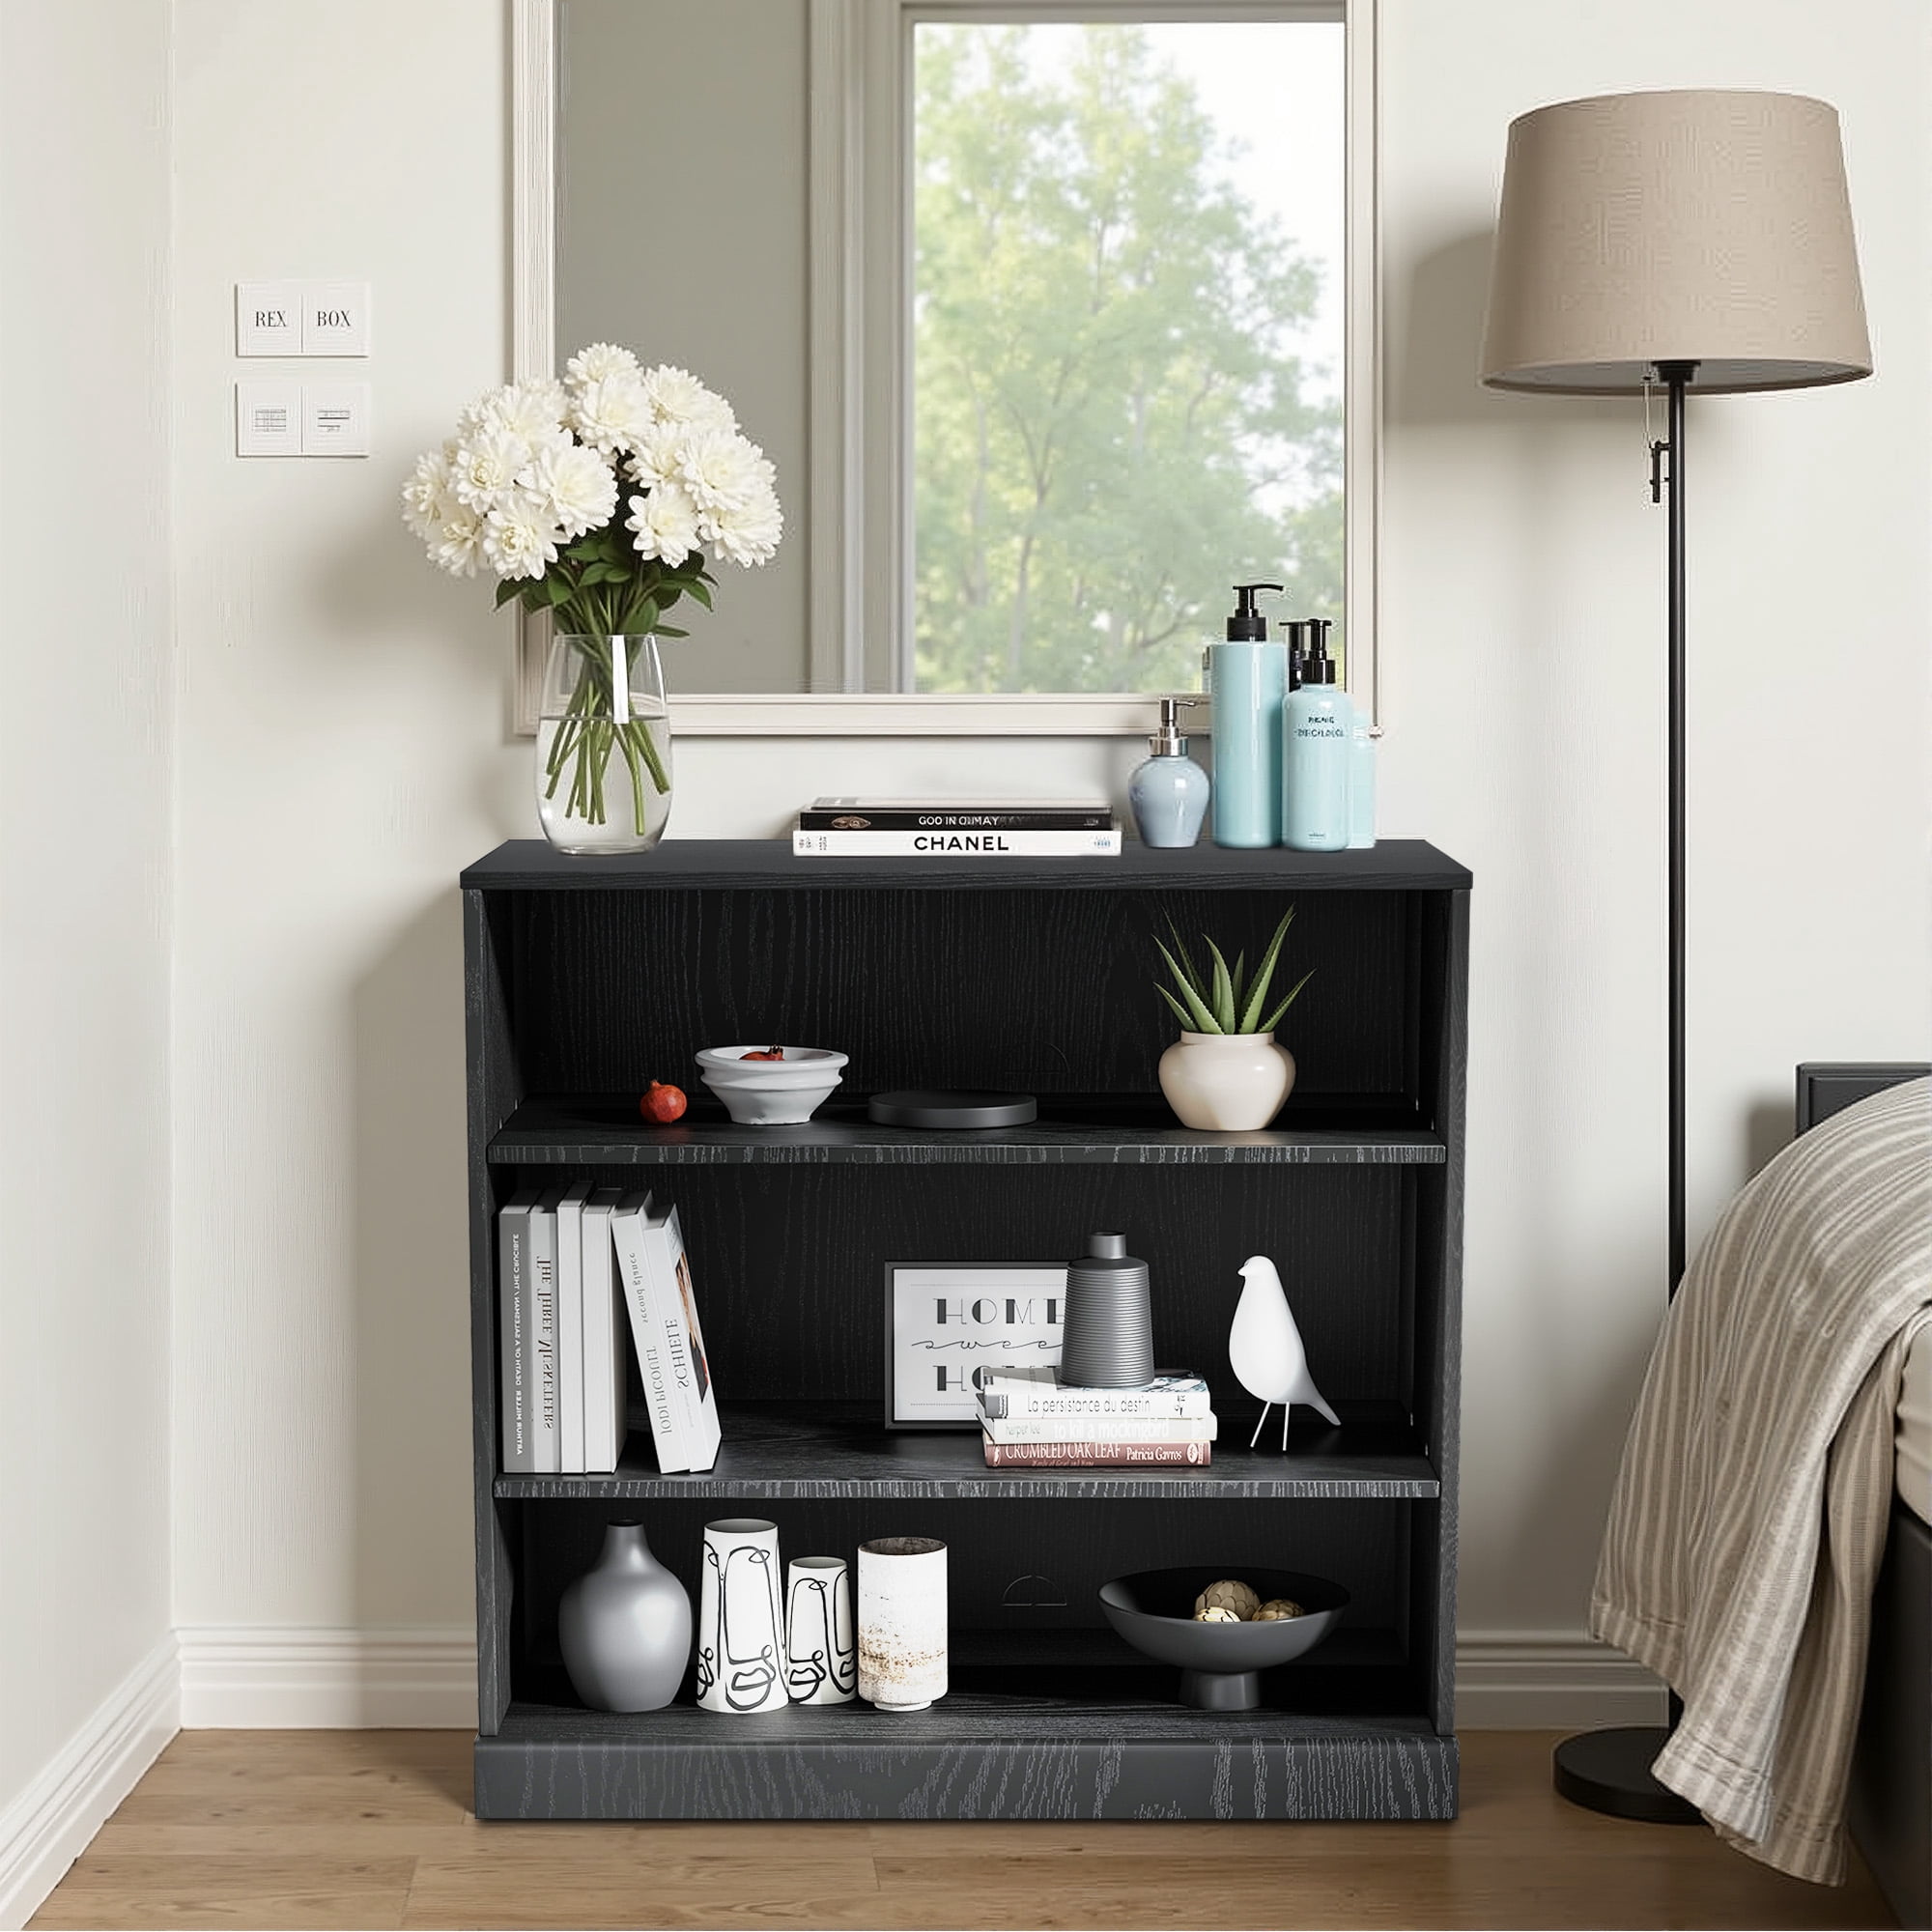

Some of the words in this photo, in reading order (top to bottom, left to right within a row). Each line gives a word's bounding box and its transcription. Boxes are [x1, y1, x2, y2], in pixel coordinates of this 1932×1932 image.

[255, 310, 287, 327] REX
[317, 310, 351, 327] BOX
[914, 837, 1009, 851] CHANEL
[932, 1297, 1066, 1325] HOME
[911, 1339, 1065, 1350] swee
[1028, 1394, 1038, 1412] La
[1042, 1395, 1100, 1419] persistance
[1103, 1395, 1117, 1412] du
[1121, 1394, 1151, 1412] destin
[1006, 1442, 1066, 1460] CRUMBLED
[1066, 1442, 1093, 1460] OAK
[1094, 1441, 1121, 1459] LEAF
[1126, 1447, 1154, 1462] Patricia
